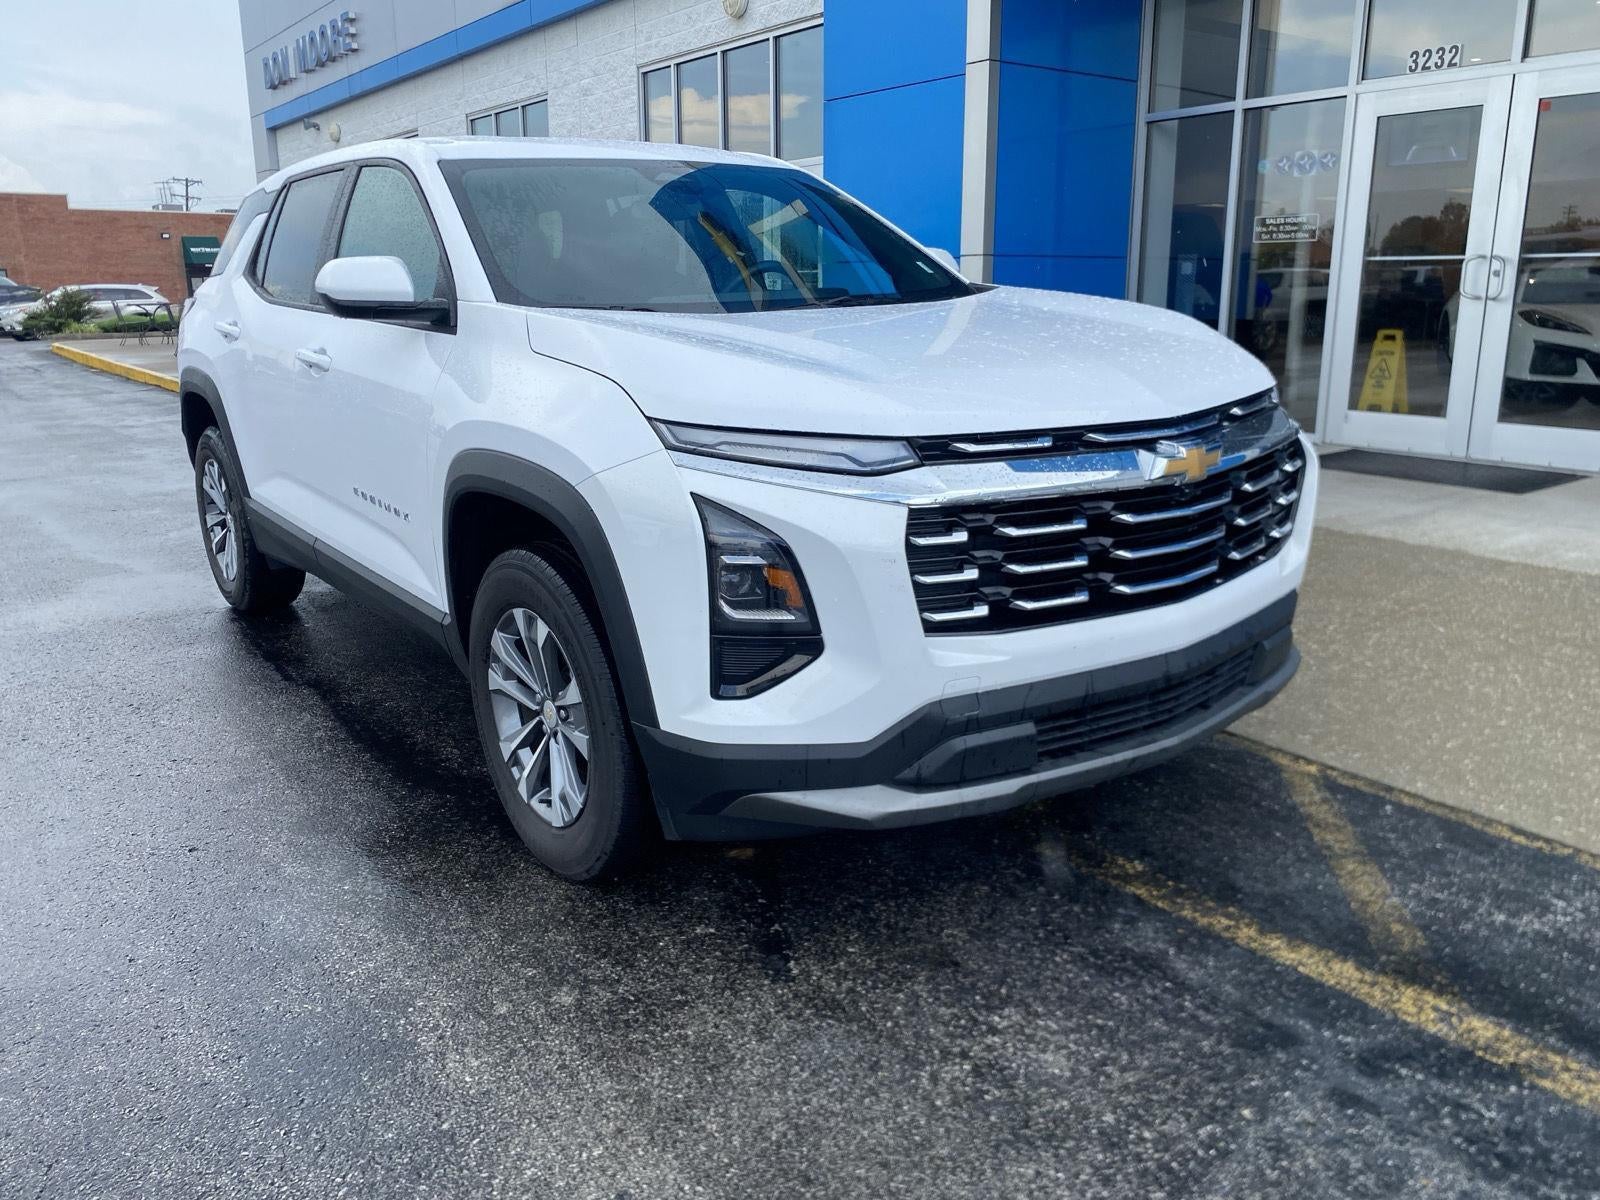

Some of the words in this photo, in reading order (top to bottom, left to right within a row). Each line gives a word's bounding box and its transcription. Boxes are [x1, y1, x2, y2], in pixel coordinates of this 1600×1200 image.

[296, 11, 358, 73] MOORE
[1408, 44, 1460, 73] 3232
[1265, 217, 1285, 225] SALES
